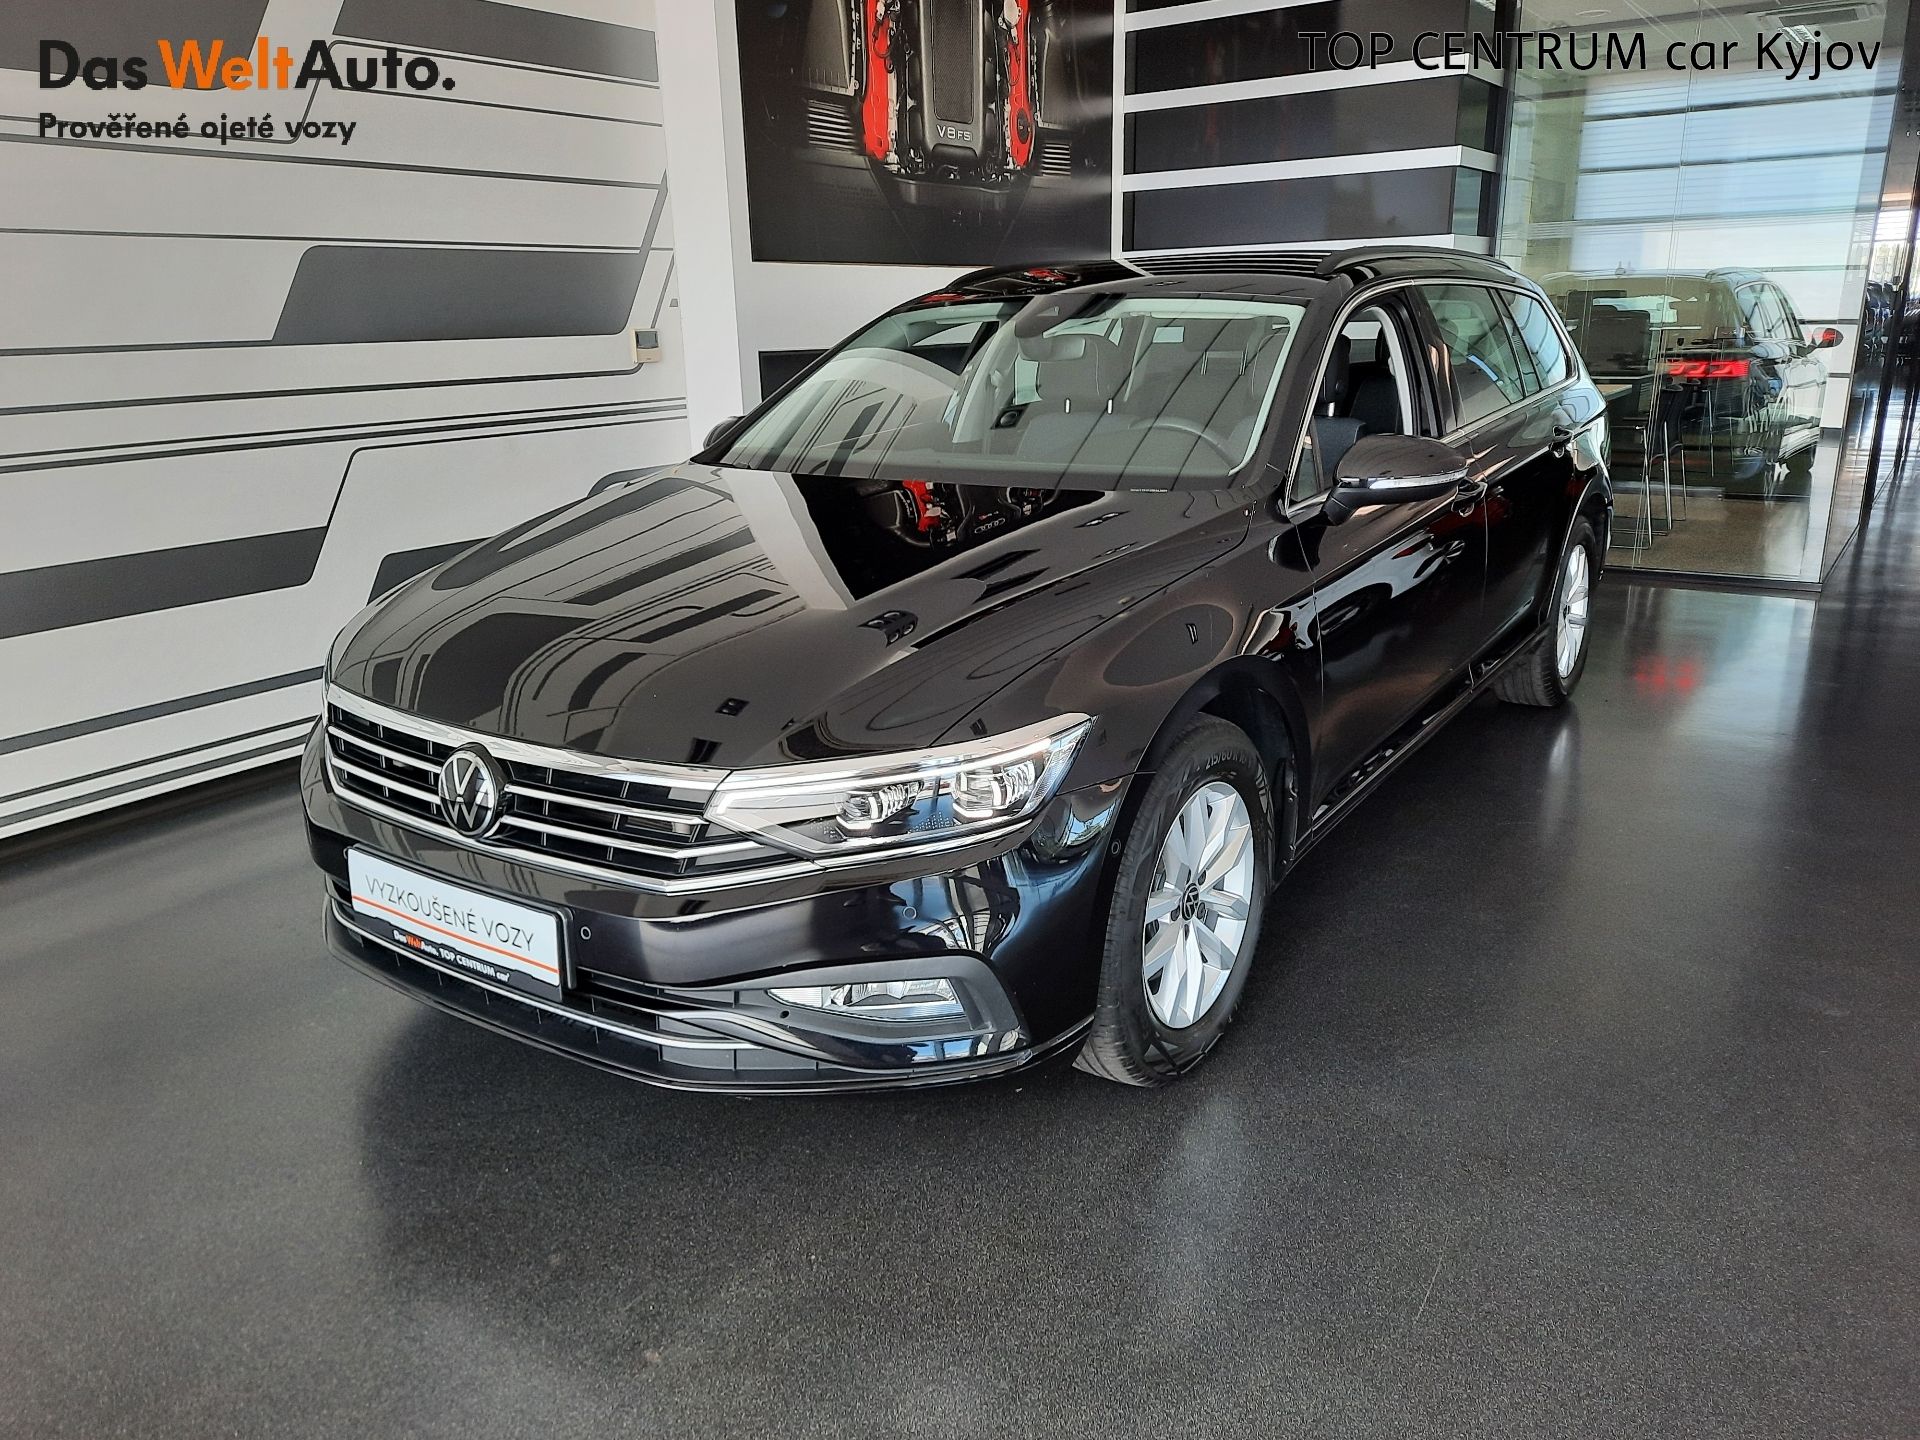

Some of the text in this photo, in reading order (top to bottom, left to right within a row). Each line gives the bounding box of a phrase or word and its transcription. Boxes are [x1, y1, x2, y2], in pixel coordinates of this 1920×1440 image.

[365, 874, 534, 951] VYZKOUŠENÉ VOZY
[439, 947, 455, 961] TOP
[456, 954, 496, 977] CENTRUM
